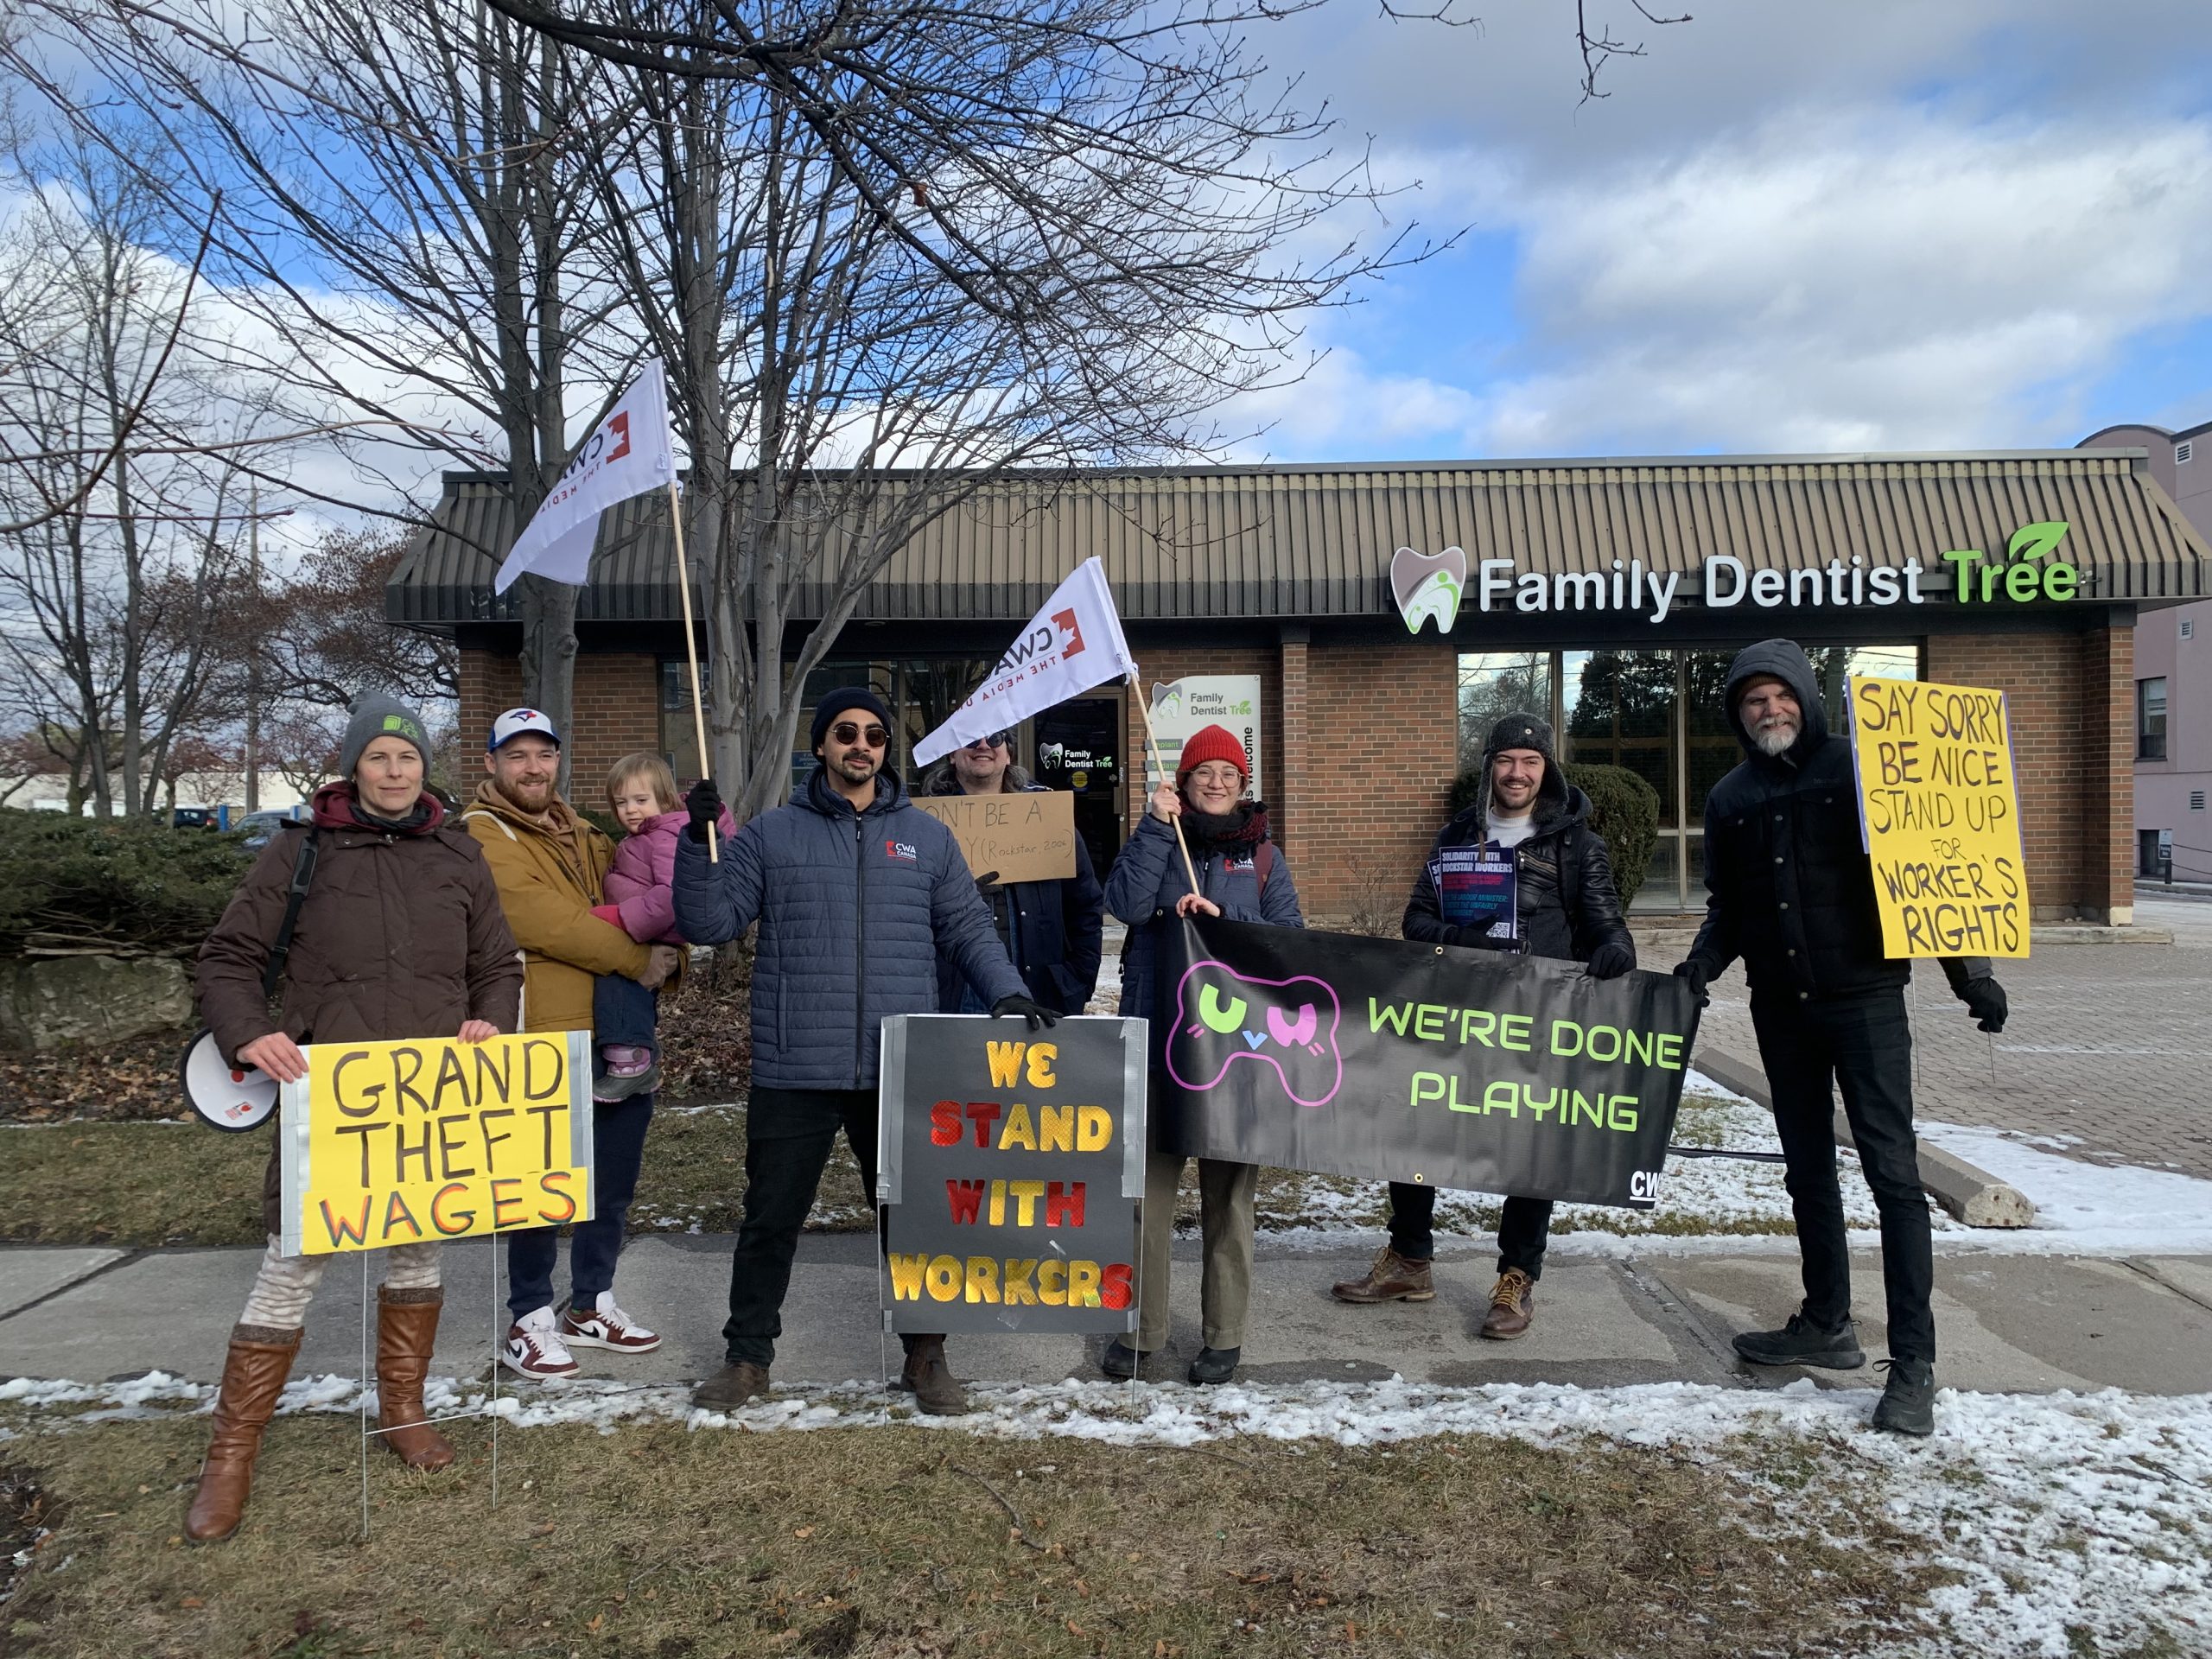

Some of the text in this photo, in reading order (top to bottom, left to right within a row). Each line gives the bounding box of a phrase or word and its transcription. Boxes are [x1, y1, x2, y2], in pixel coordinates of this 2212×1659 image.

[1480, 550, 2078, 623] Family Dentist Tree
[1190, 693, 1224, 704] Family
[1191, 704, 1252, 715] Dentist Tree
[1859, 683, 2004, 746] SAY SORRY
[1065, 749, 1091, 759] Family
[1065, 760, 1094, 768] Dentist
[1878, 741, 2003, 787] BE NICE
[924, 799, 1042, 828] ON'T BE A
[1869, 788, 2006, 834] STAND UP
[895, 842, 916, 854] CWA
[1442, 851, 1500, 861] SOLIDARITY ITH
[1442, 863, 1473, 872] ROCKSTAR
[1474, 863, 1513, 873] WORKERS
[1930, 837, 1967, 861] FOR
[1878, 854, 2019, 904] WORKER'S
[1902, 902, 2019, 954] RIGHTS
[1369, 996, 1684, 1071] WE'RE DONE
[333, 1039, 563, 1118] GRAND
[986, 1040, 1058, 1089] WE
[1410, 1071, 1639, 1132] PLAYING
[335, 1104, 569, 1188] THEFT
[930, 1100, 1113, 1152] STAND
[320, 1171, 576, 1248] WAGES
[945, 1179, 1086, 1227] WITH
[888, 1252, 1134, 1310] WORKERS
